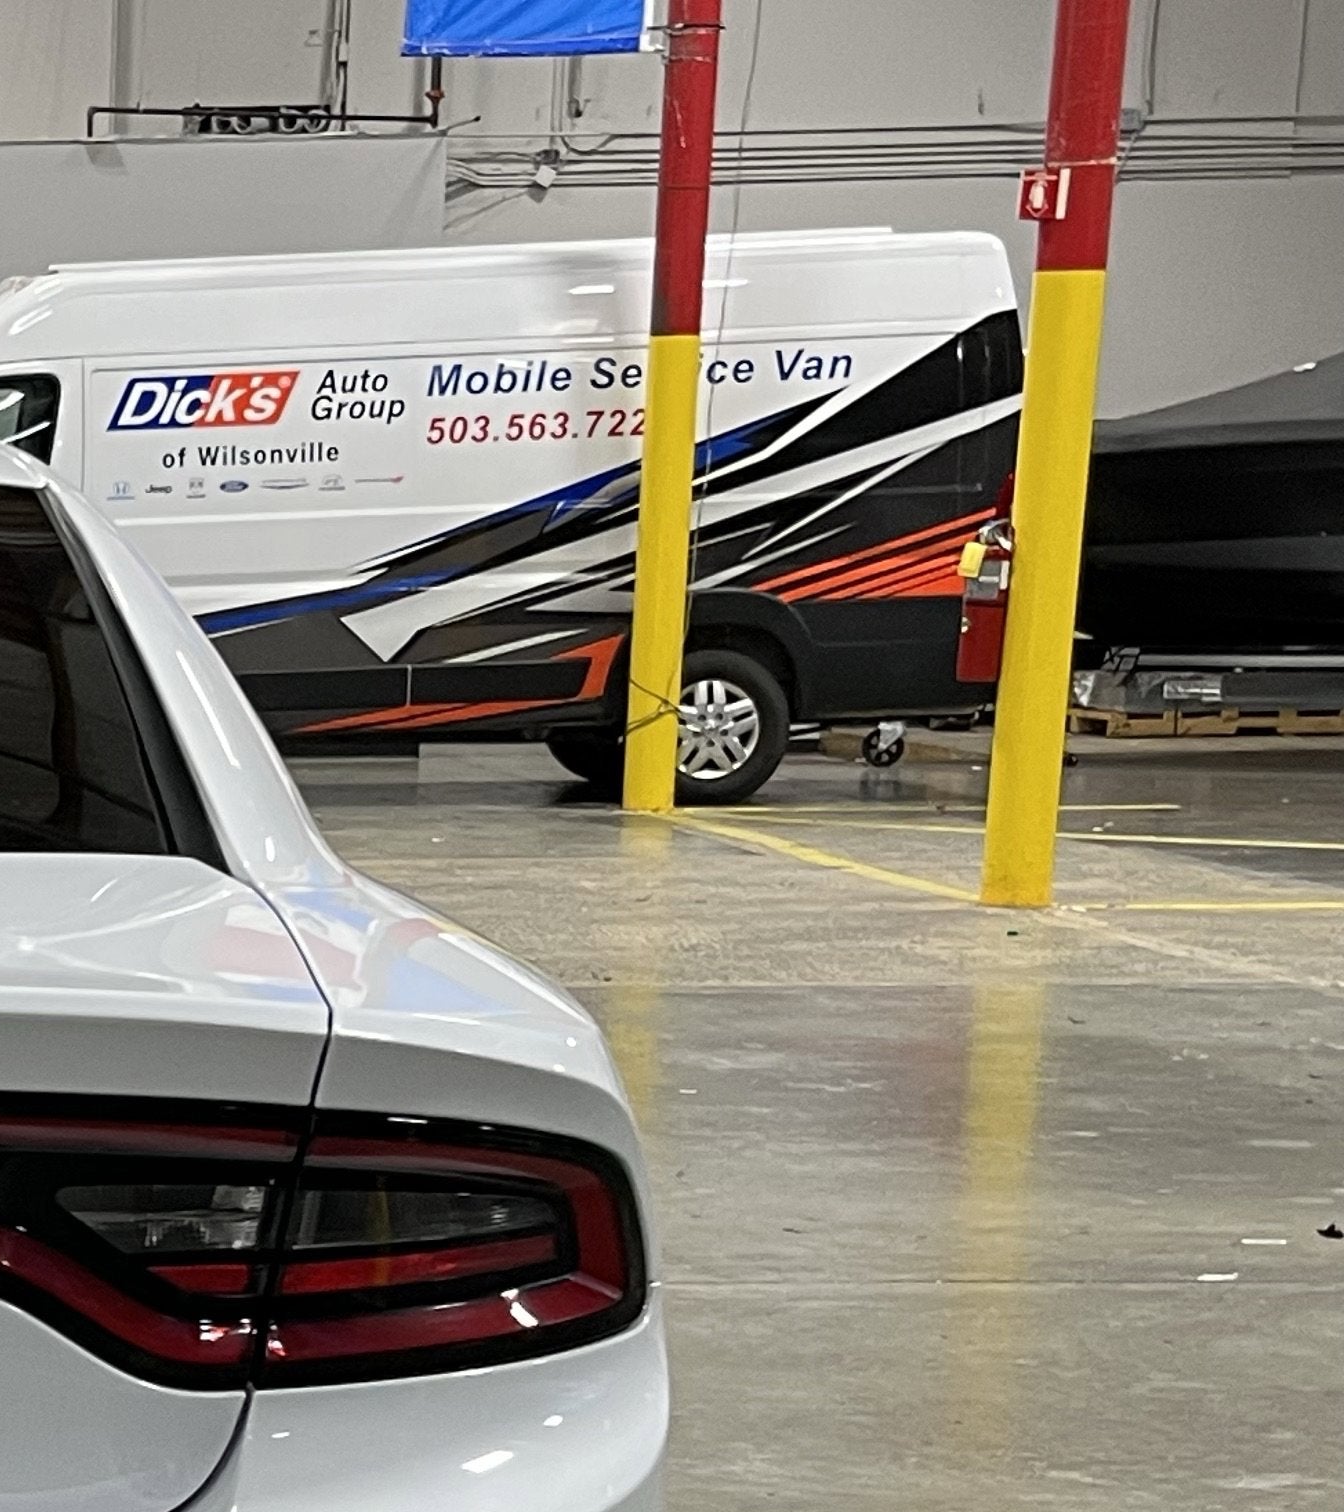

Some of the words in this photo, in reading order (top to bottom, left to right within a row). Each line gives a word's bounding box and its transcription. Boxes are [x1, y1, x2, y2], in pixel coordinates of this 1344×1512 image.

[426, 360, 572, 396] Mobile
[774, 349, 853, 382] Van
[118, 378, 277, 425] Dick's
[316, 370, 388, 394] Auto
[312, 396, 406, 426] Group
[162, 450, 187, 468] of
[197, 442, 340, 468] Wilsonville
